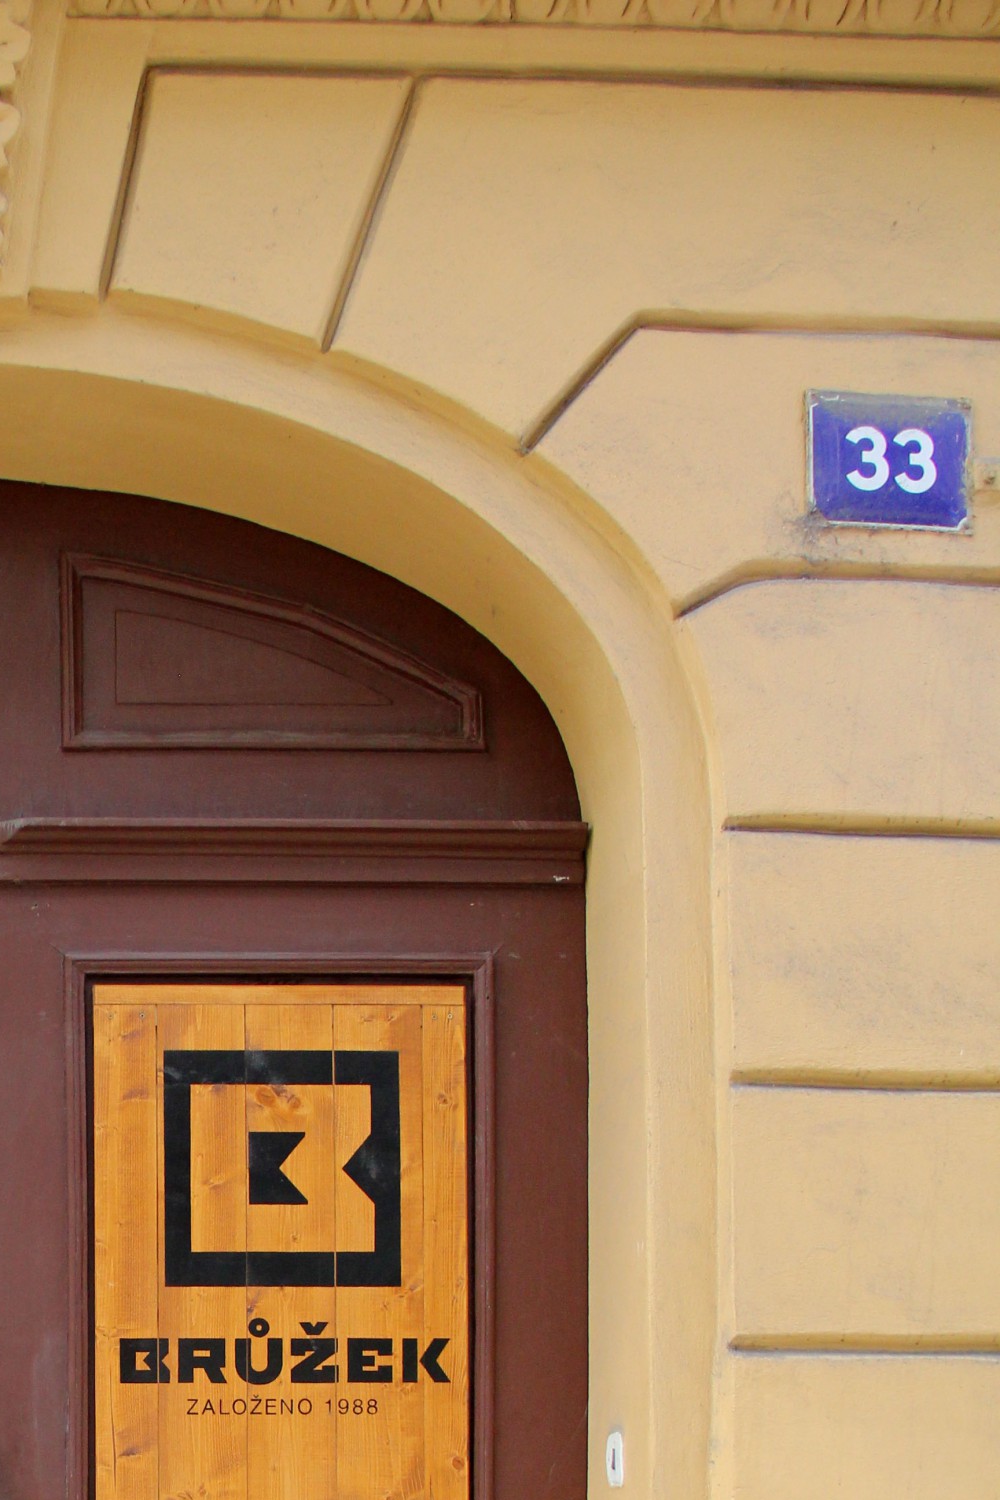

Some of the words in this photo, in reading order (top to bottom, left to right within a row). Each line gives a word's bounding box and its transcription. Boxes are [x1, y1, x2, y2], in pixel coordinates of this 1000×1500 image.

[845, 425, 938, 494] 33
[119, 1317, 451, 1385] BRŮŽEK
[186, 1394, 313, 1416] ZALOŽENO
[325, 1398, 379, 1415] 1988
